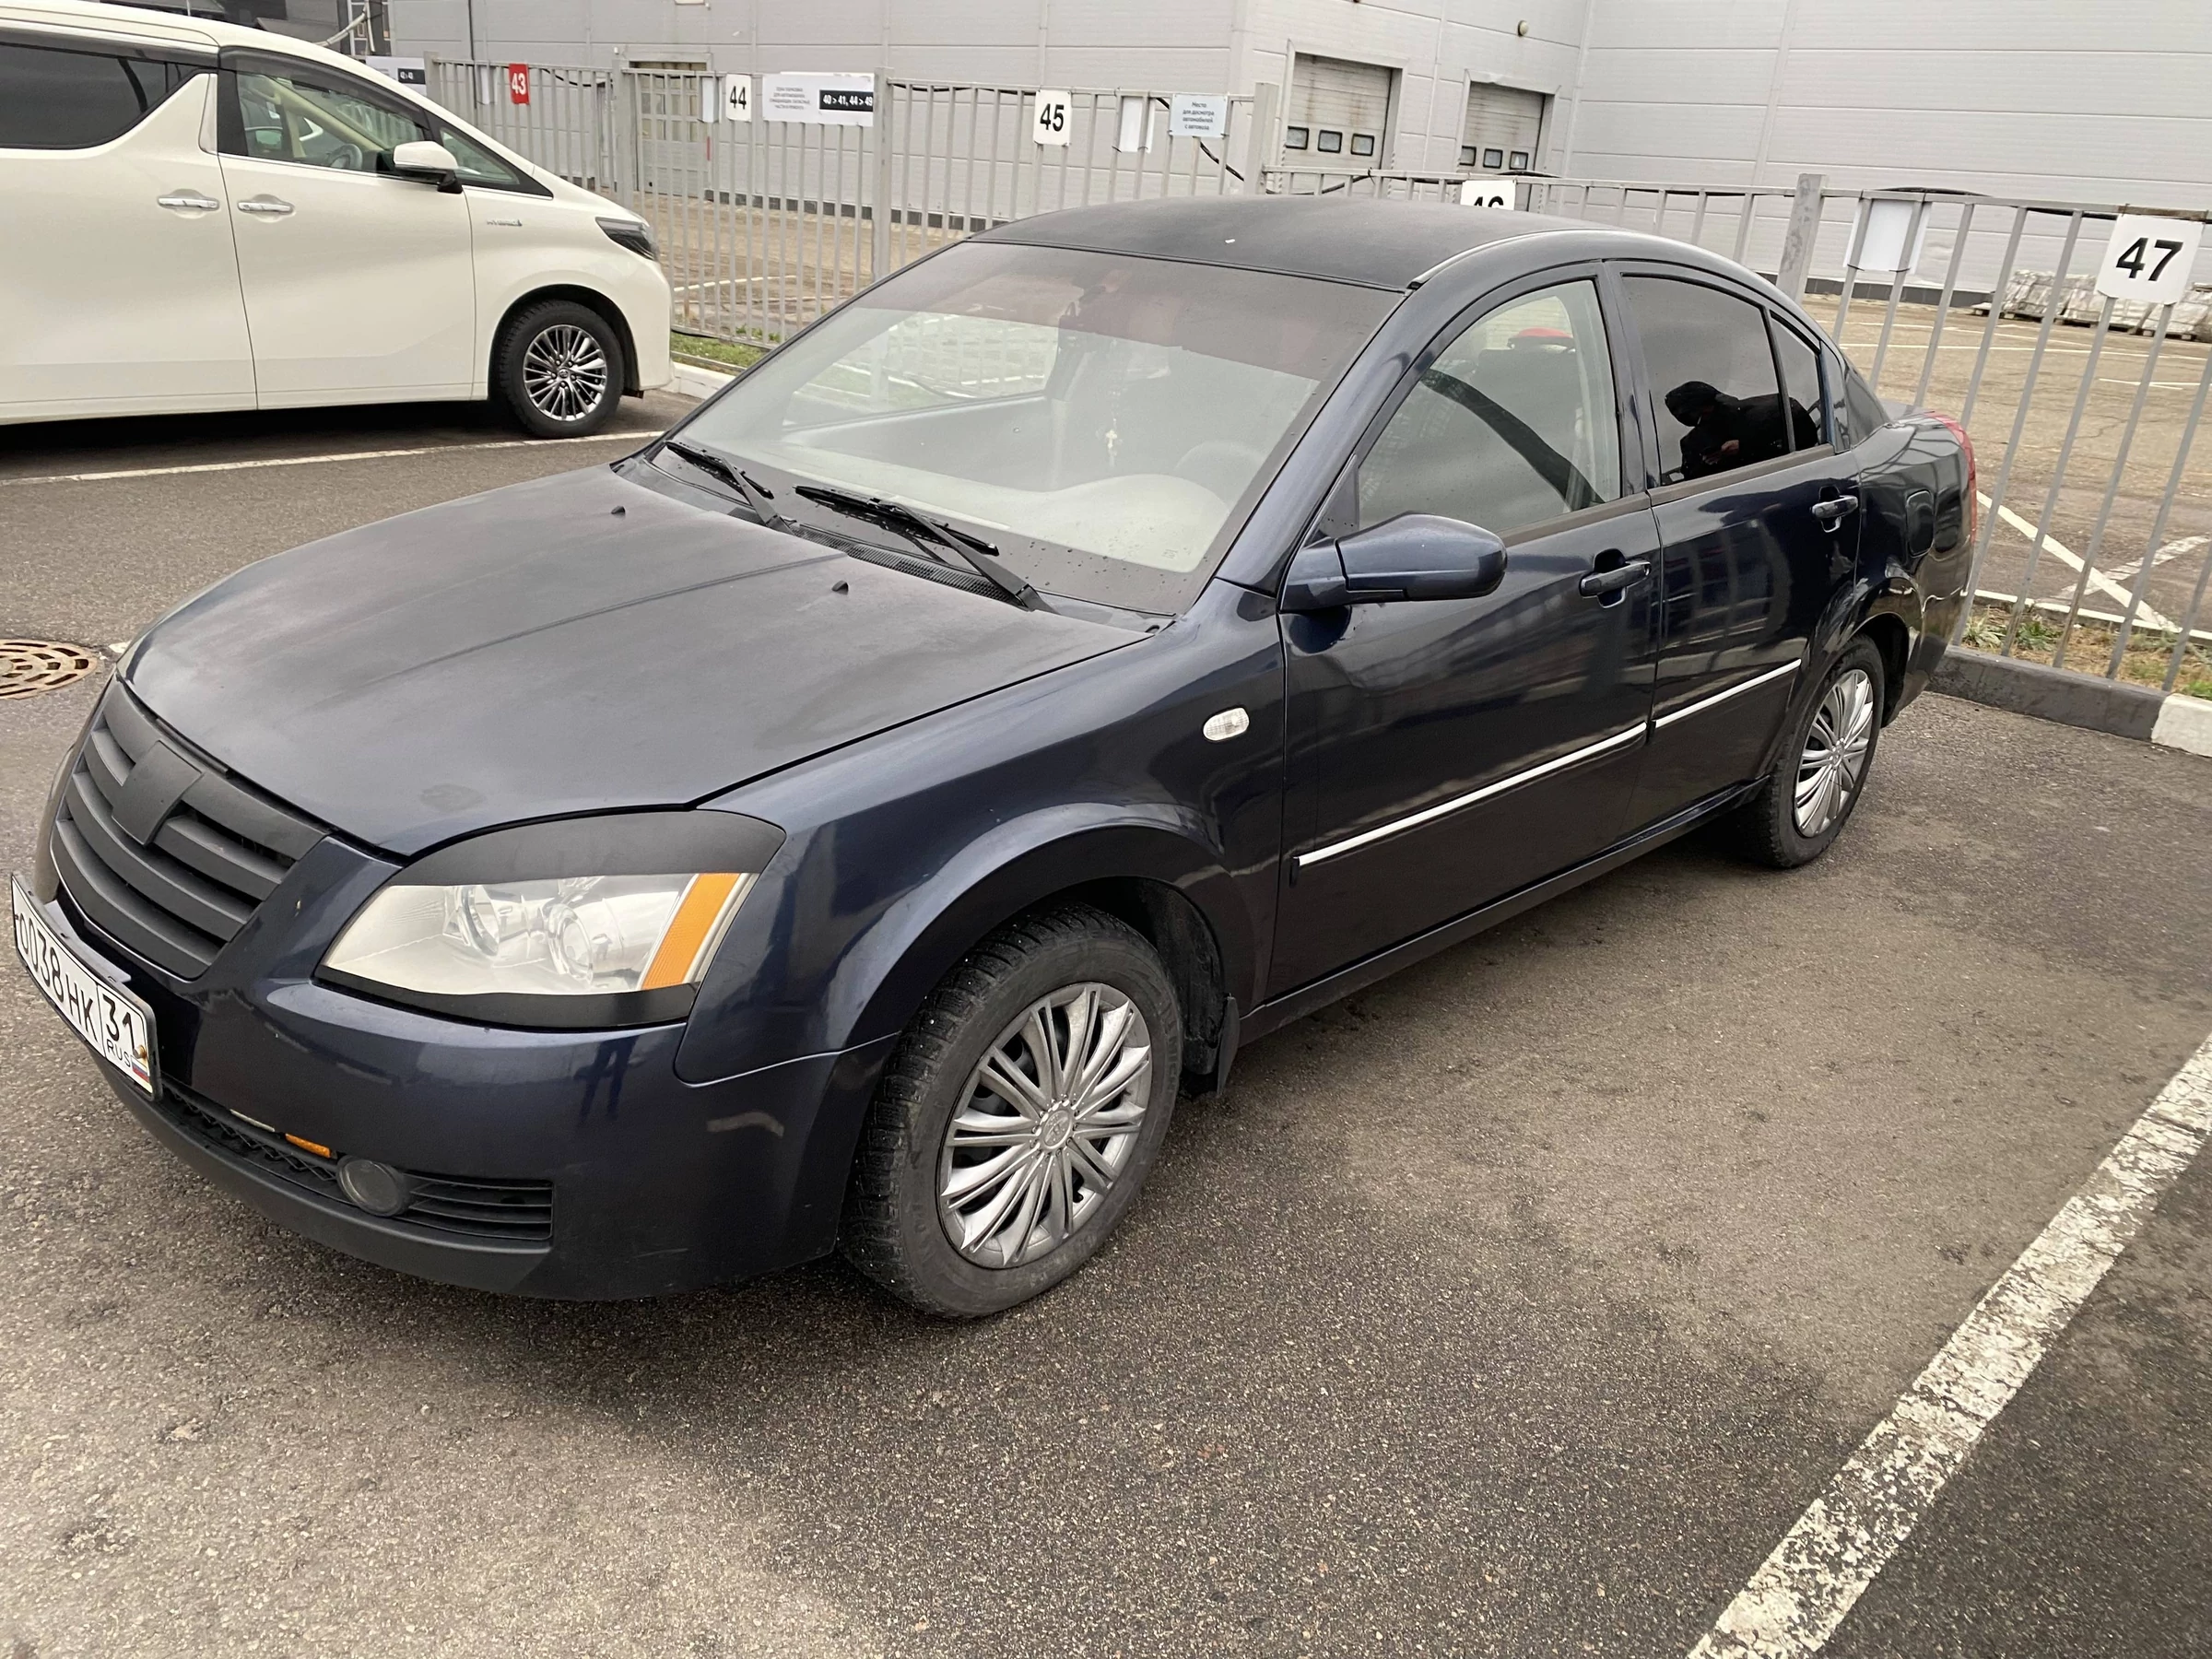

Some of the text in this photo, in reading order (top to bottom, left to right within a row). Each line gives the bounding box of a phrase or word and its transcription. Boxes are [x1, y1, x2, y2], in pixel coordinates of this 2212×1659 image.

[512, 72, 526, 95] 43
[729, 85, 747, 110] 44
[822, 94, 832, 105] 40
[849, 95, 858, 106] 44
[1040, 103, 1065, 132] 45
[2115, 237, 2184, 282] 47
[102, 994, 135, 1049] 31
[106, 1038, 132, 1069] RUS
